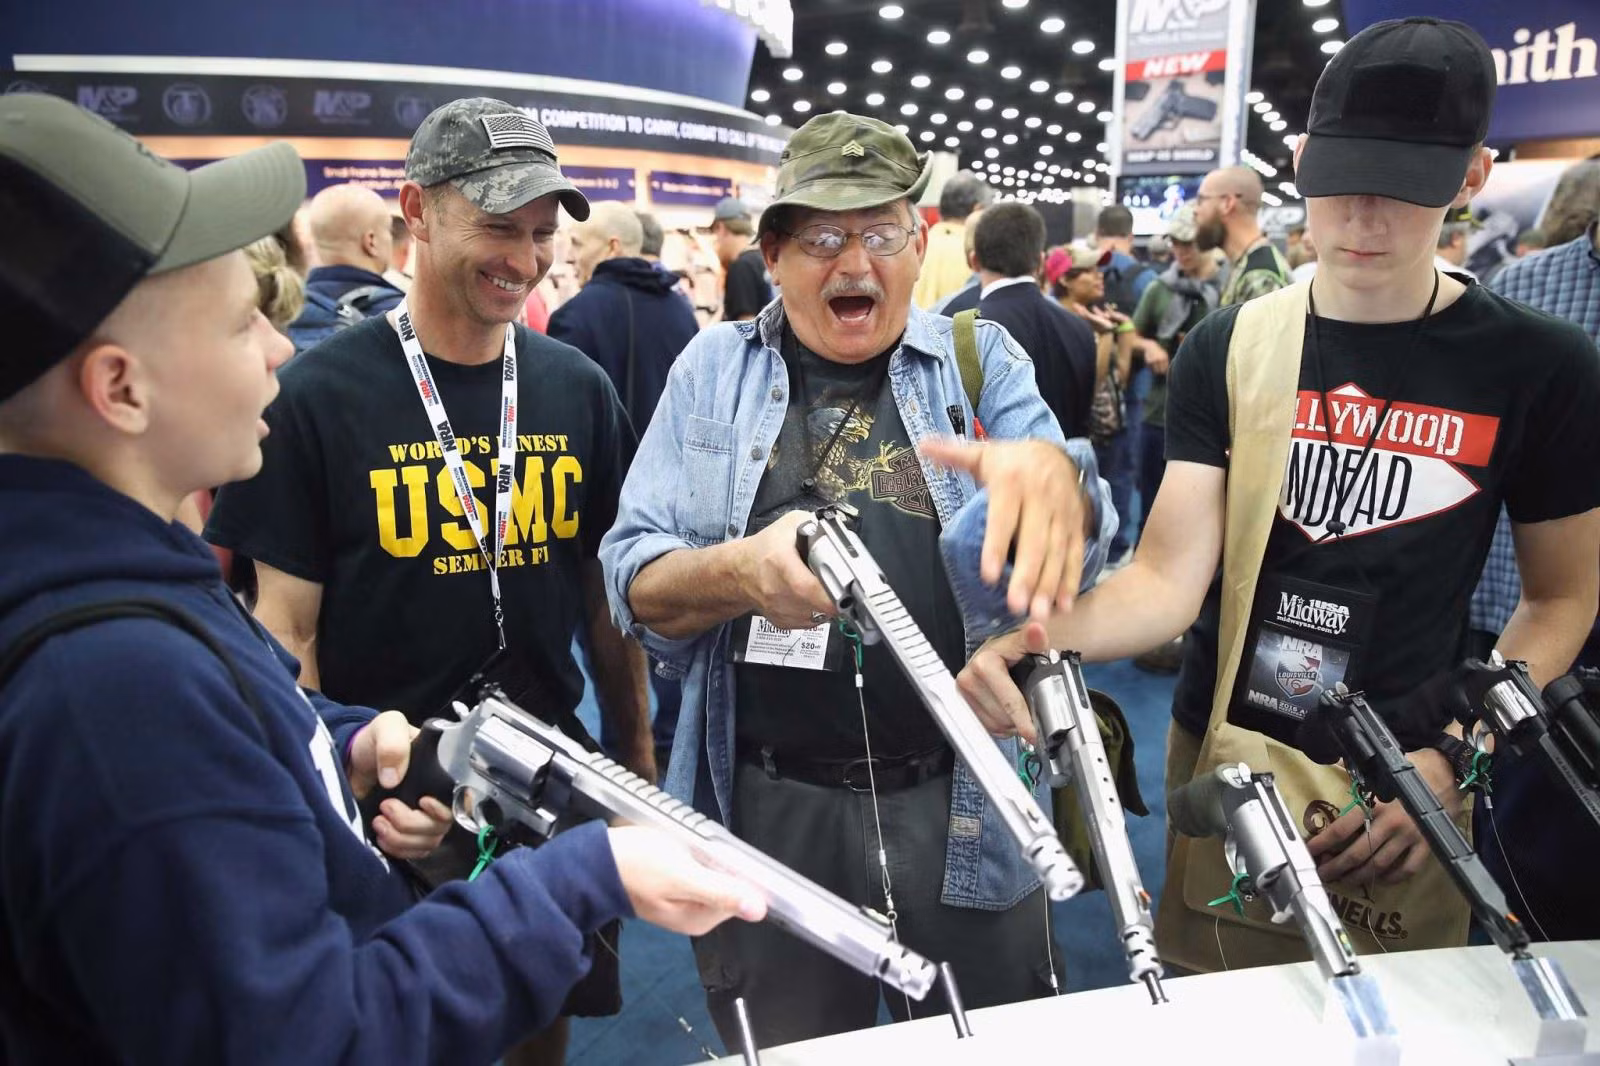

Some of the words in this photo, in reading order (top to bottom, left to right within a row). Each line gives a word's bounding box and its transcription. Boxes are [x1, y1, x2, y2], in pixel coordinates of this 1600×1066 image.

[1143, 52, 1211, 78] NEW
[1491, 22, 1598, 86] ith
[77, 85, 138, 112] M&P
[314, 90, 371, 116] M&P
[541, 108, 626, 132] COMPETITION
[627, 116, 642, 134] TO
[398, 312, 416, 341] NRA
[504, 355, 514, 381] NRA
[436, 420, 457, 453] NRA
[1295, 397, 1464, 457] LLYWOOD
[388, 435, 491, 463] WORD'S
[496, 434, 569, 456] NEST
[498, 463, 511, 493] NRA
[1286, 440, 1413, 528] NDEAD
[369, 456, 583, 558] USMC
[1276, 591, 1351, 635] Midway
[801, 642, 815, 650] $20
[1281, 635, 1323, 660] NRA
[1277, 671, 1318, 680] LOUISVILLE
[1247, 690, 1278, 710] NRA
[1327, 891, 1402, 936] NELLS
